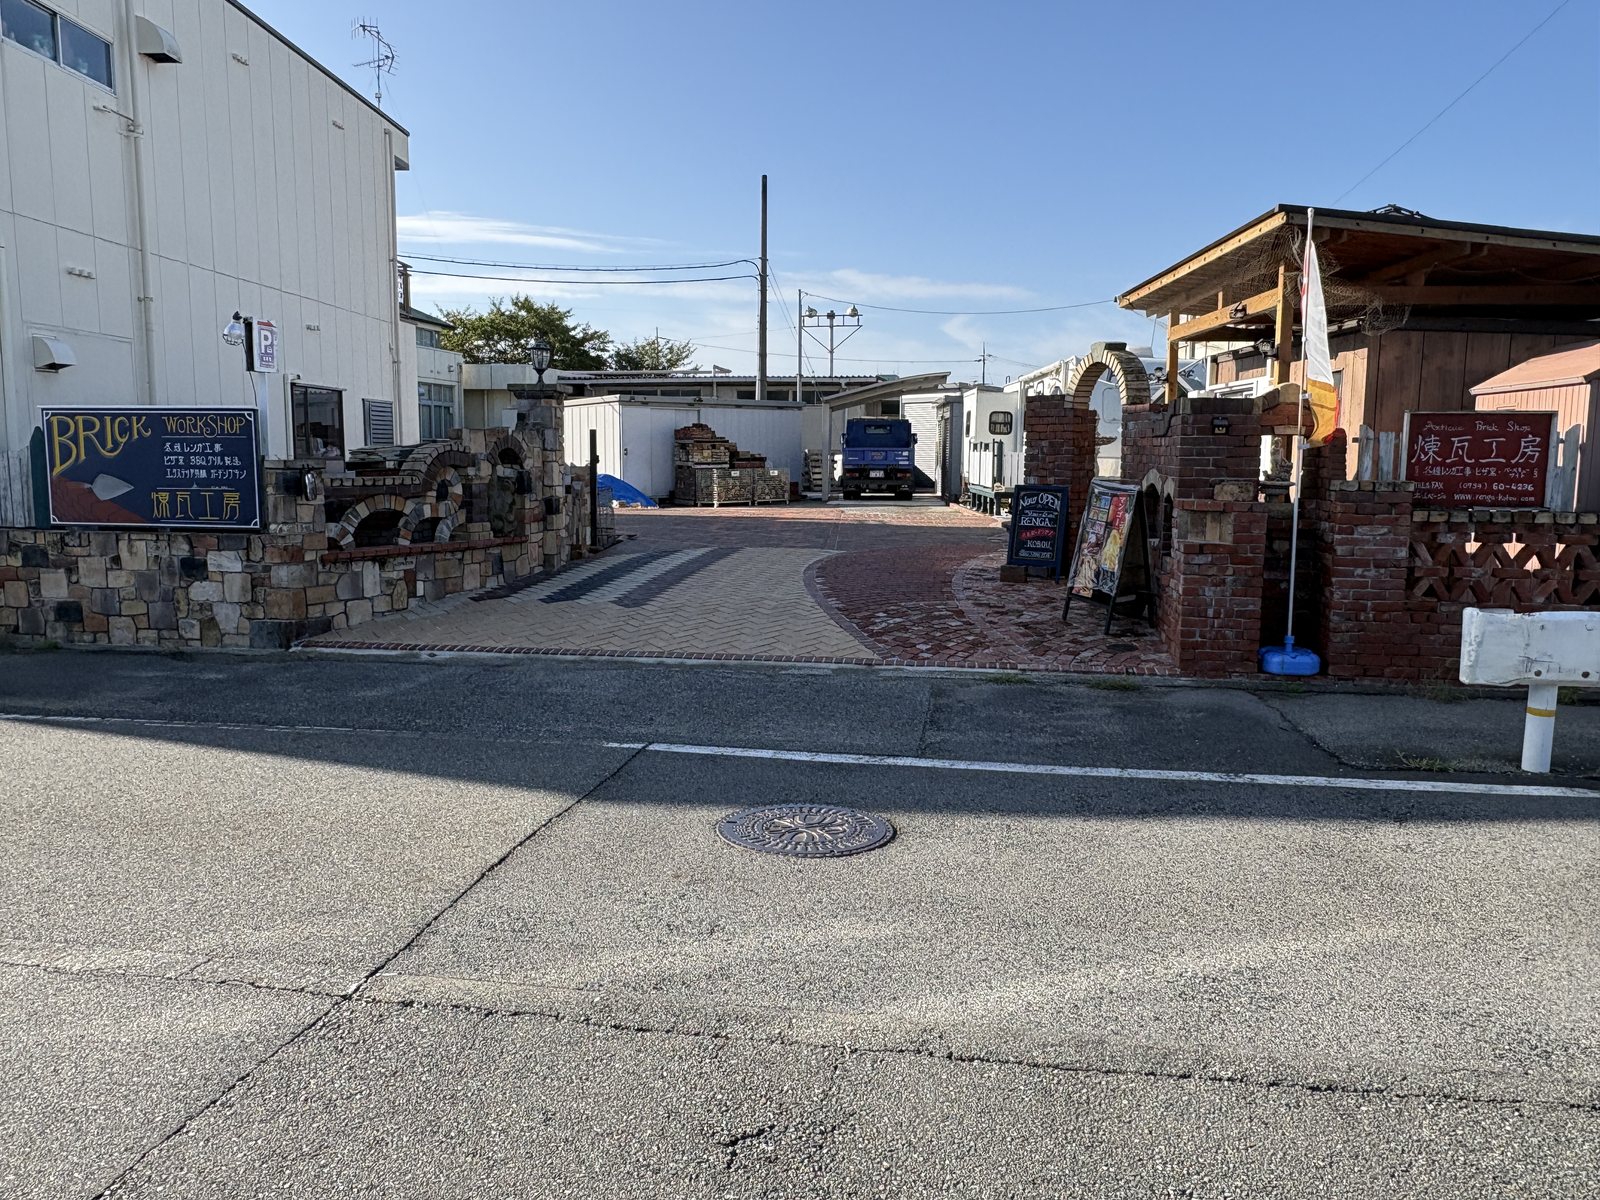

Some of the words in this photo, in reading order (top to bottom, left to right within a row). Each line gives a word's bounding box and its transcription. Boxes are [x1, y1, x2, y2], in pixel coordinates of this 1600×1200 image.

[260, 330, 272, 354] P
[50, 415, 152, 477] BRICK
[162, 414, 246, 438] WORKSHOP
[1410, 434, 1542, 464] 煉瓦工房
[151, 491, 241, 520] 煉瓦工房
